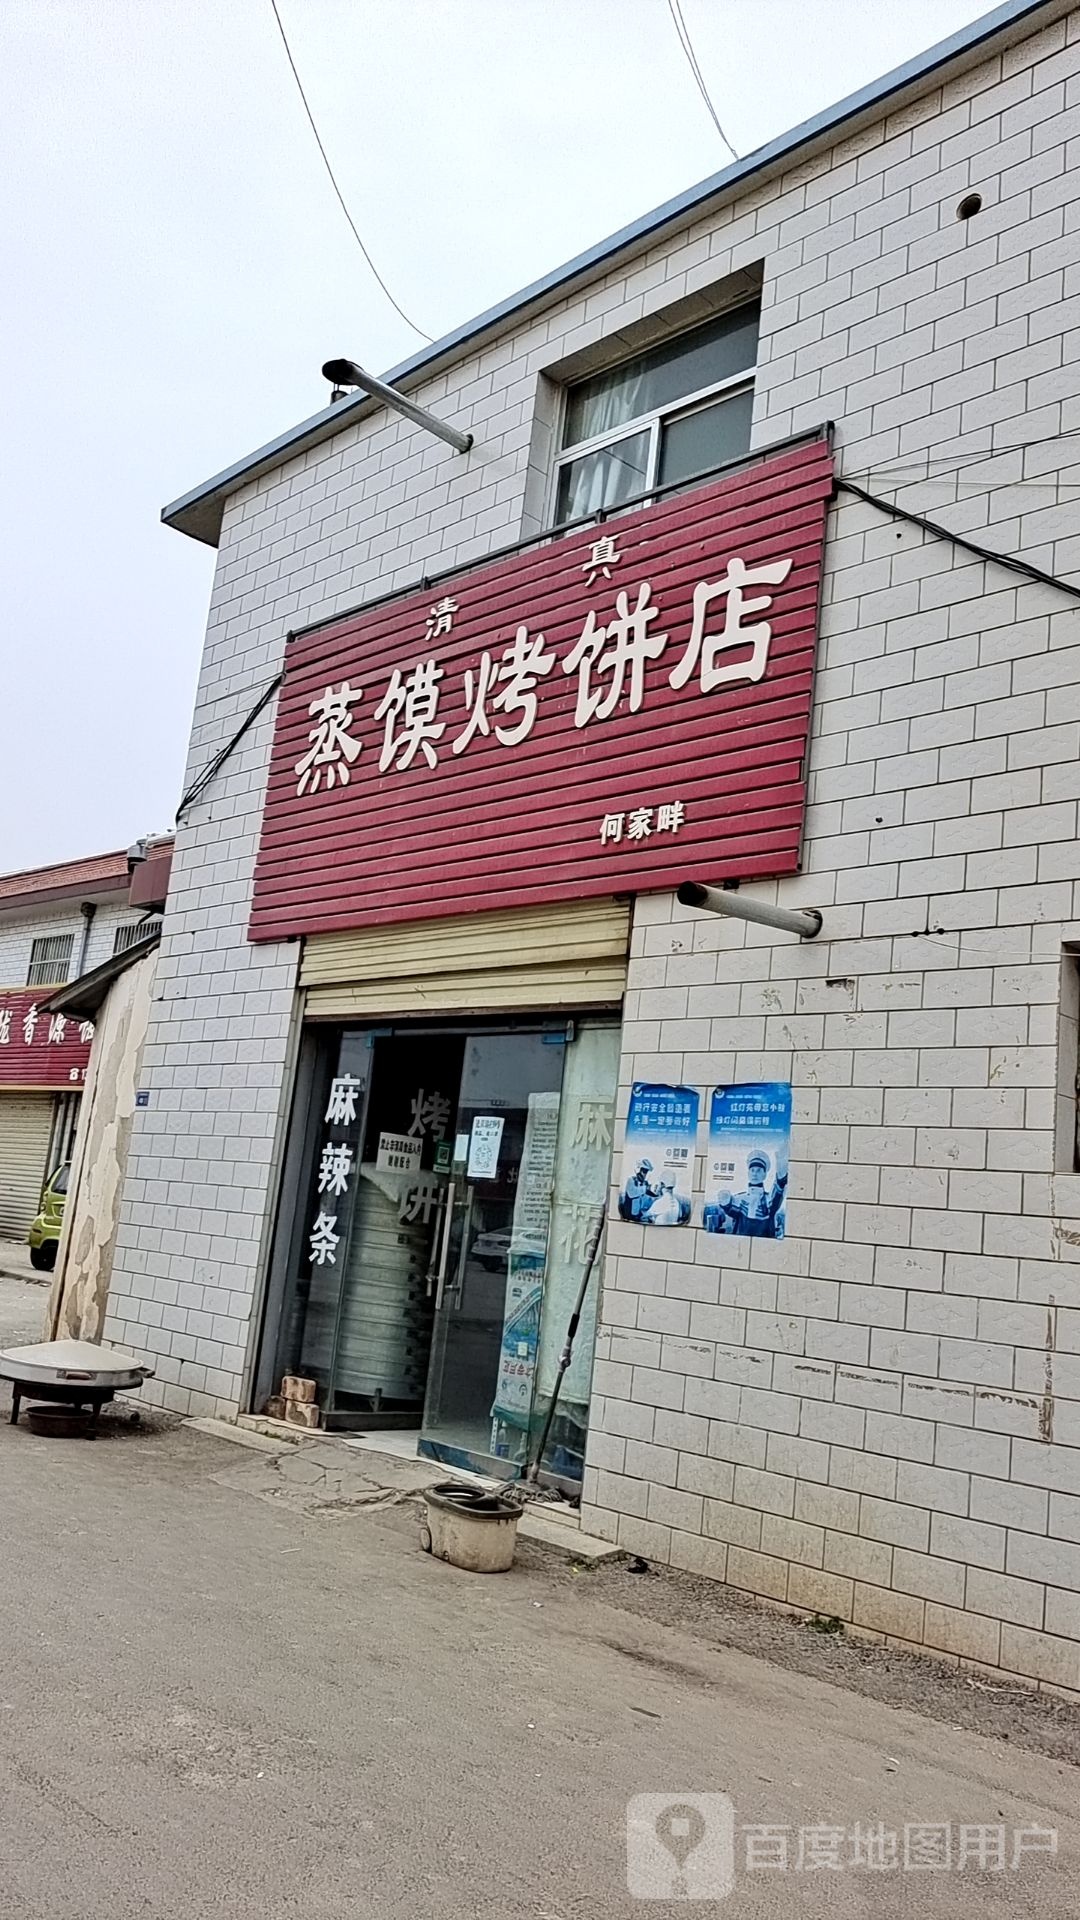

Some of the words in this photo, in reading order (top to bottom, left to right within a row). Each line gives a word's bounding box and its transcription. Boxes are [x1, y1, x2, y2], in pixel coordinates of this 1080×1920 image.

[425, 596, 460, 641] 清
[583, 535, 620, 587] 真
[294, 557, 793, 797] 蒸馍烤饼店
[599, 800, 685, 846] 何家畔
[309, 1073, 361, 1266] 麻辣条
[560, 1094, 615, 1267] 麻花
